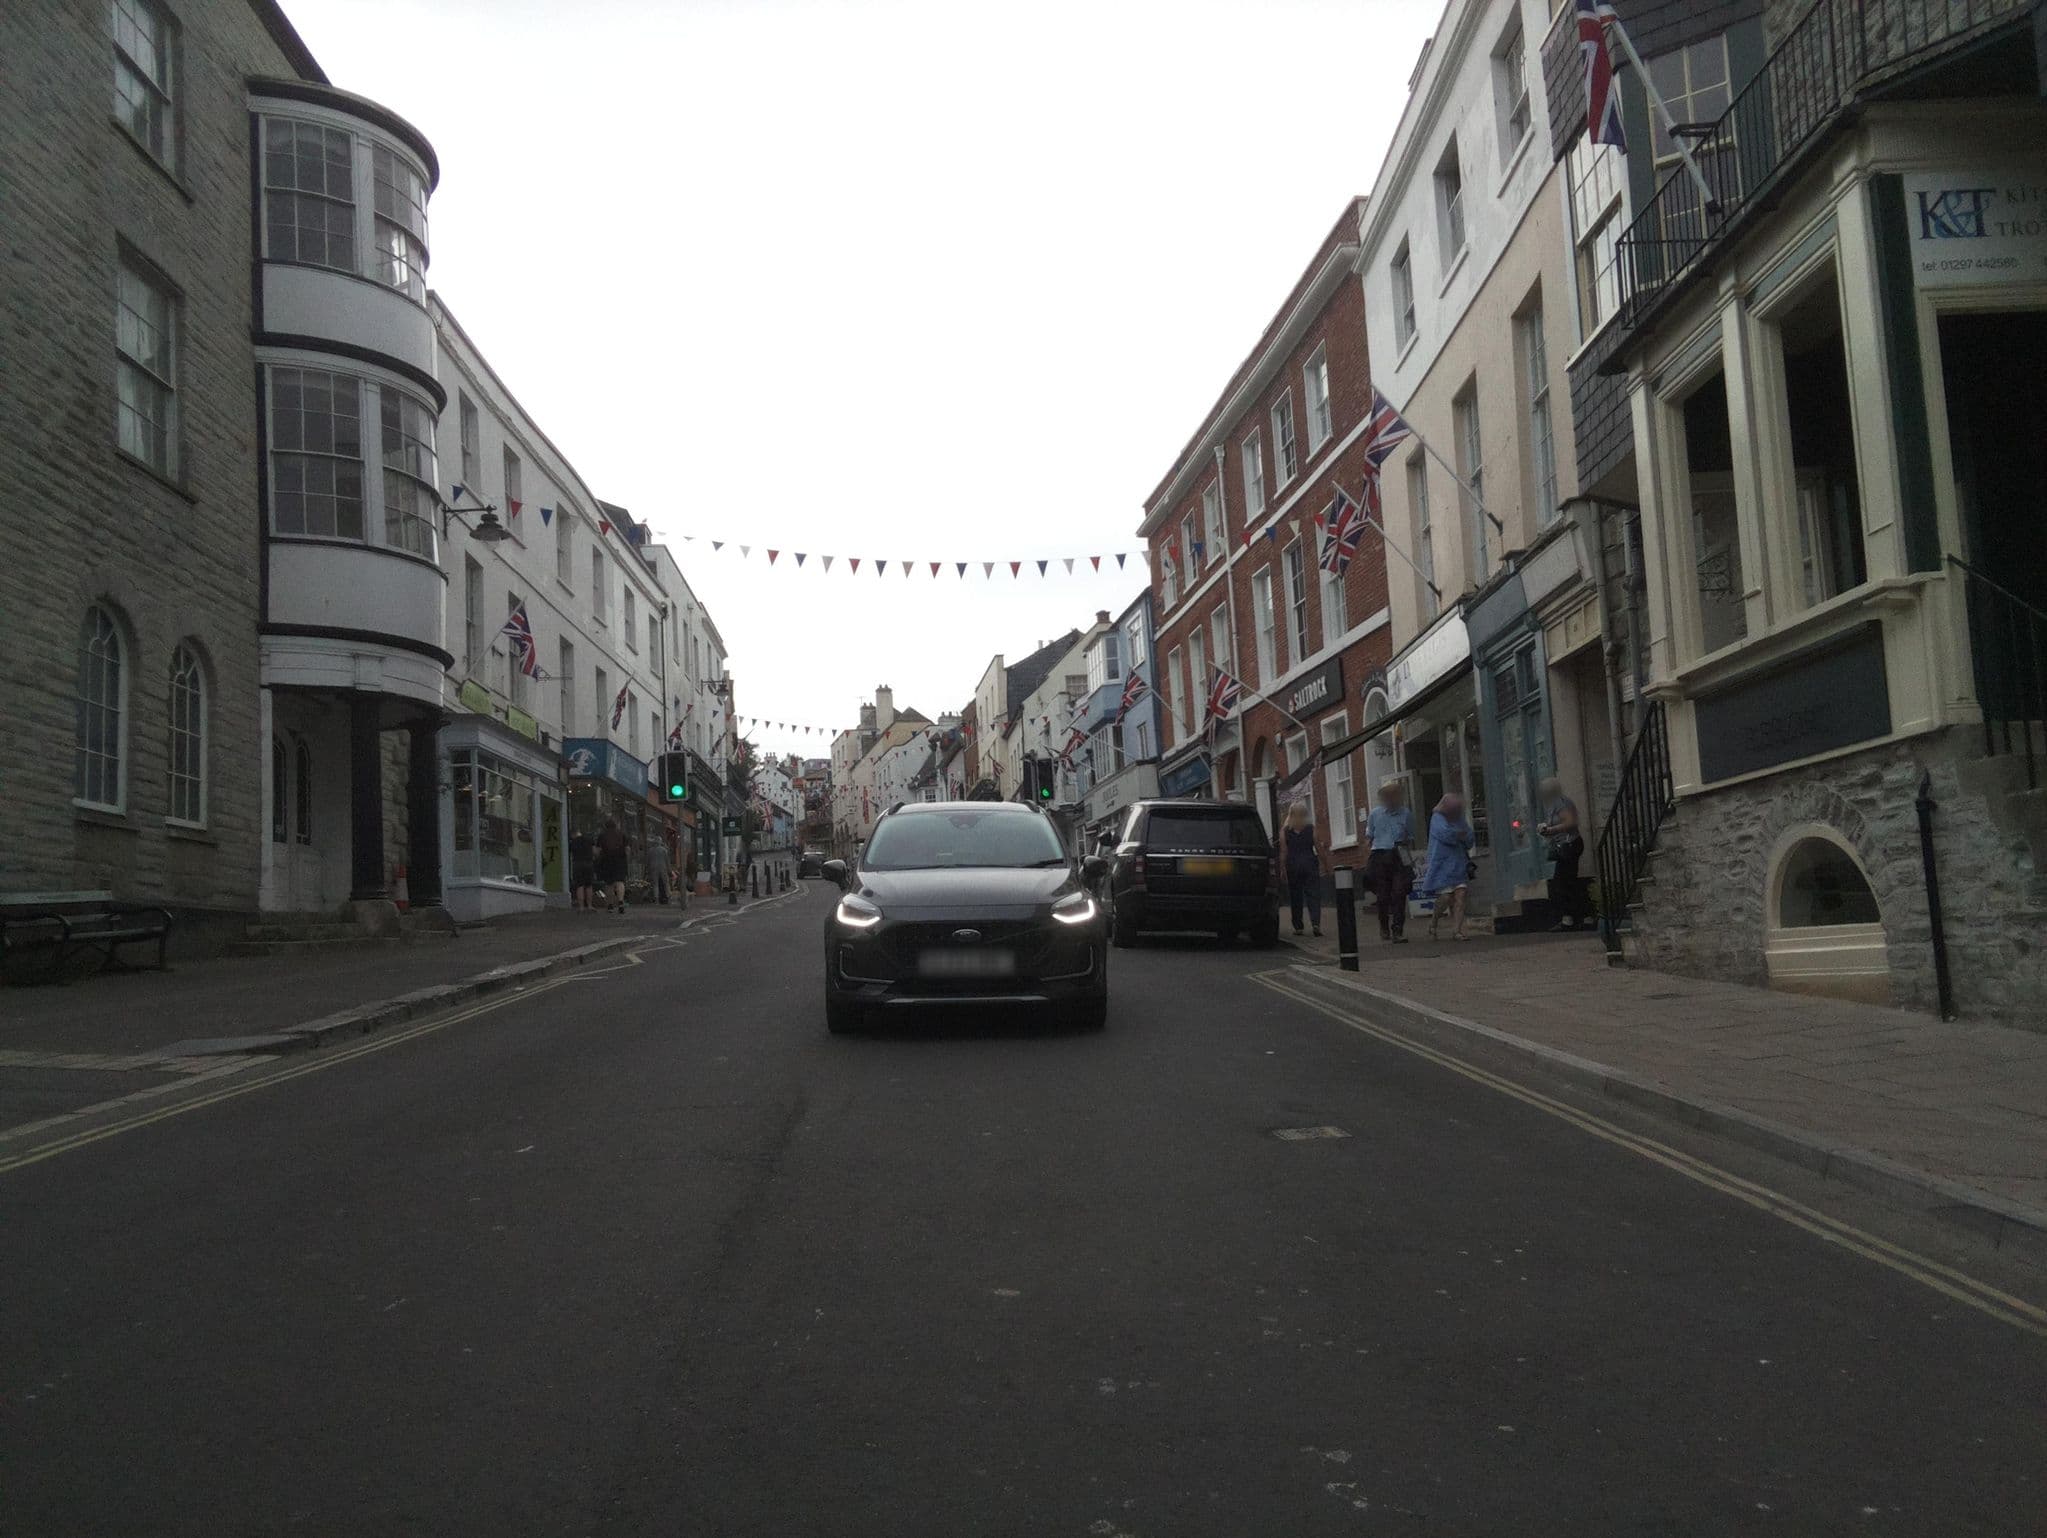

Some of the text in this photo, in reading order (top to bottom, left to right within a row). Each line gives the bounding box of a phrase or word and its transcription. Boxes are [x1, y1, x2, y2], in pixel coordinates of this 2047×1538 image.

[2006, 187, 2047, 202] KIT
[1912, 188, 1997, 240] K&T
[1294, 675, 1328, 711] SALTROCK
